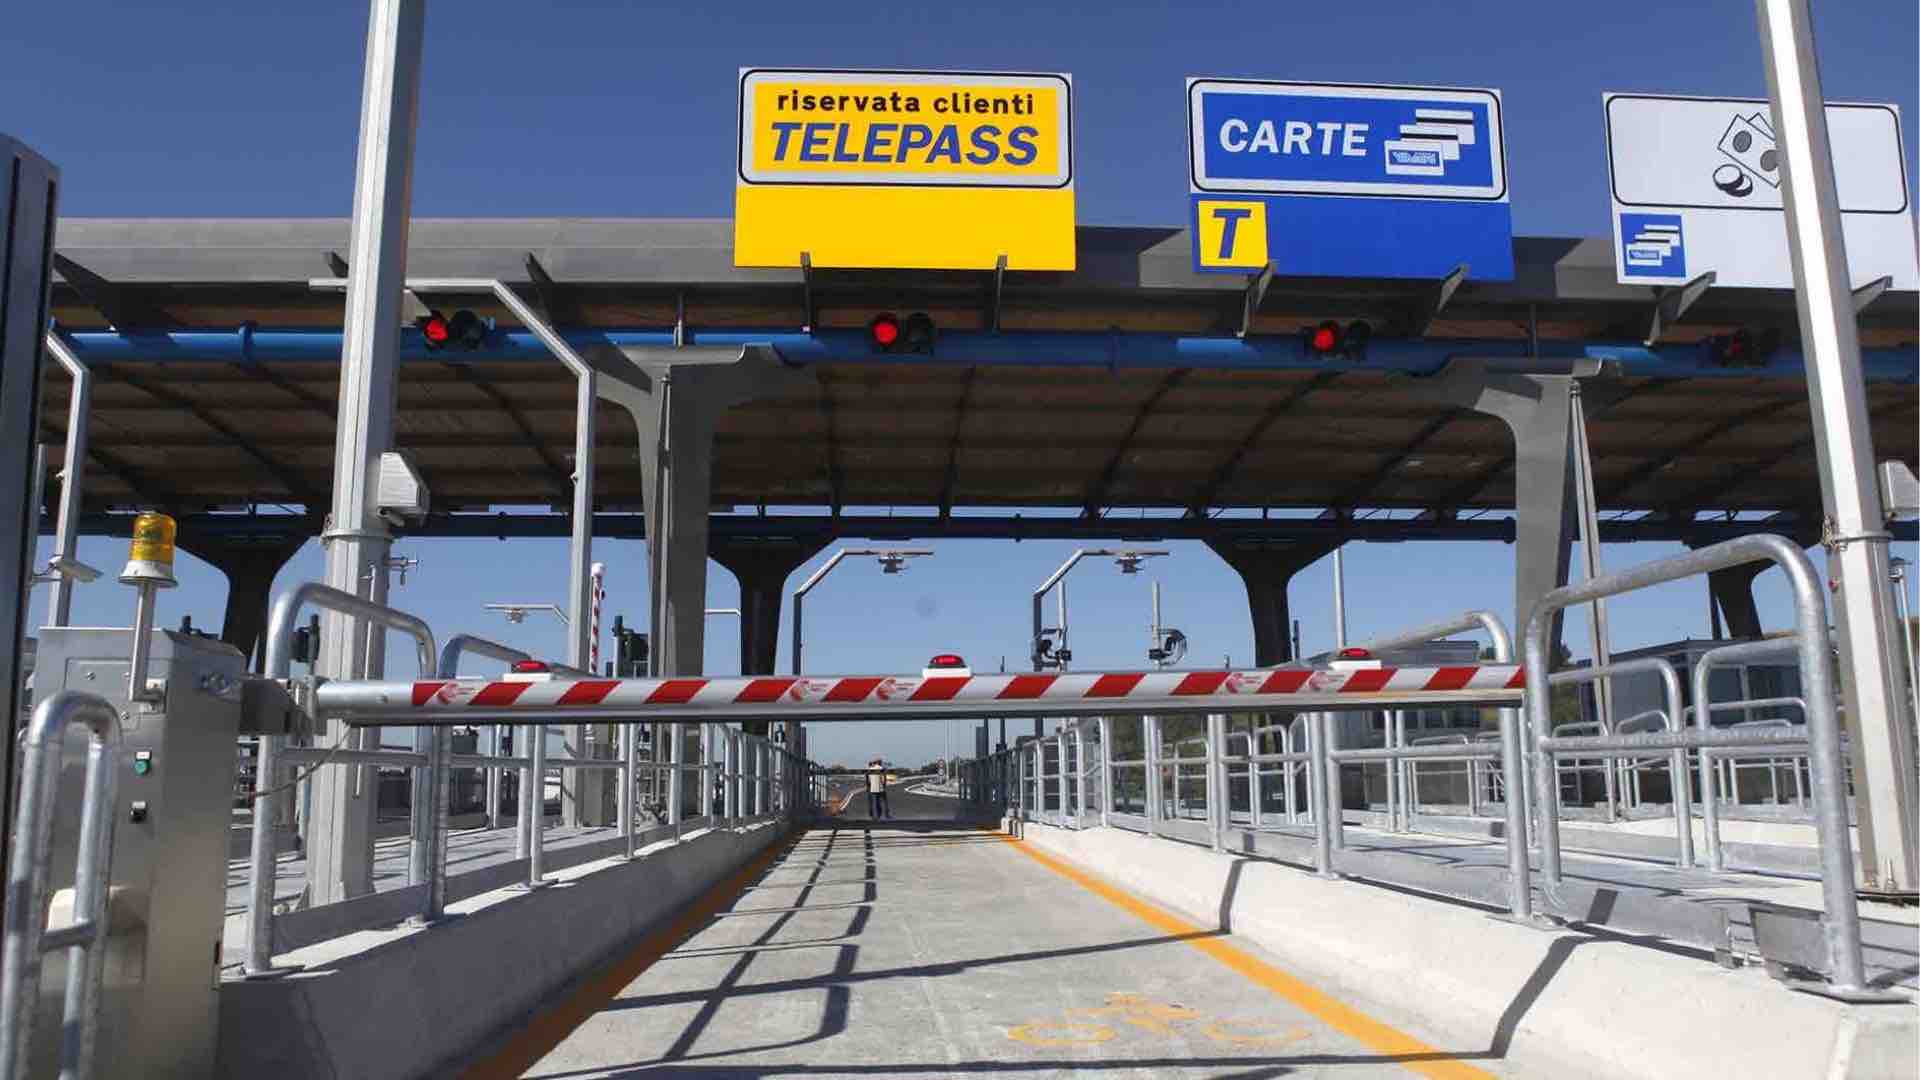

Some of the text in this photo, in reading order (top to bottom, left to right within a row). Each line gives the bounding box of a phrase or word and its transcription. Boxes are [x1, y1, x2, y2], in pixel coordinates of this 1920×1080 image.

[777, 90, 1034, 115] riservata clienti
[771, 121, 1040, 166] TELEPASS
[1219, 119, 1370, 157] CARTE
[1212, 208, 1252, 259] T
